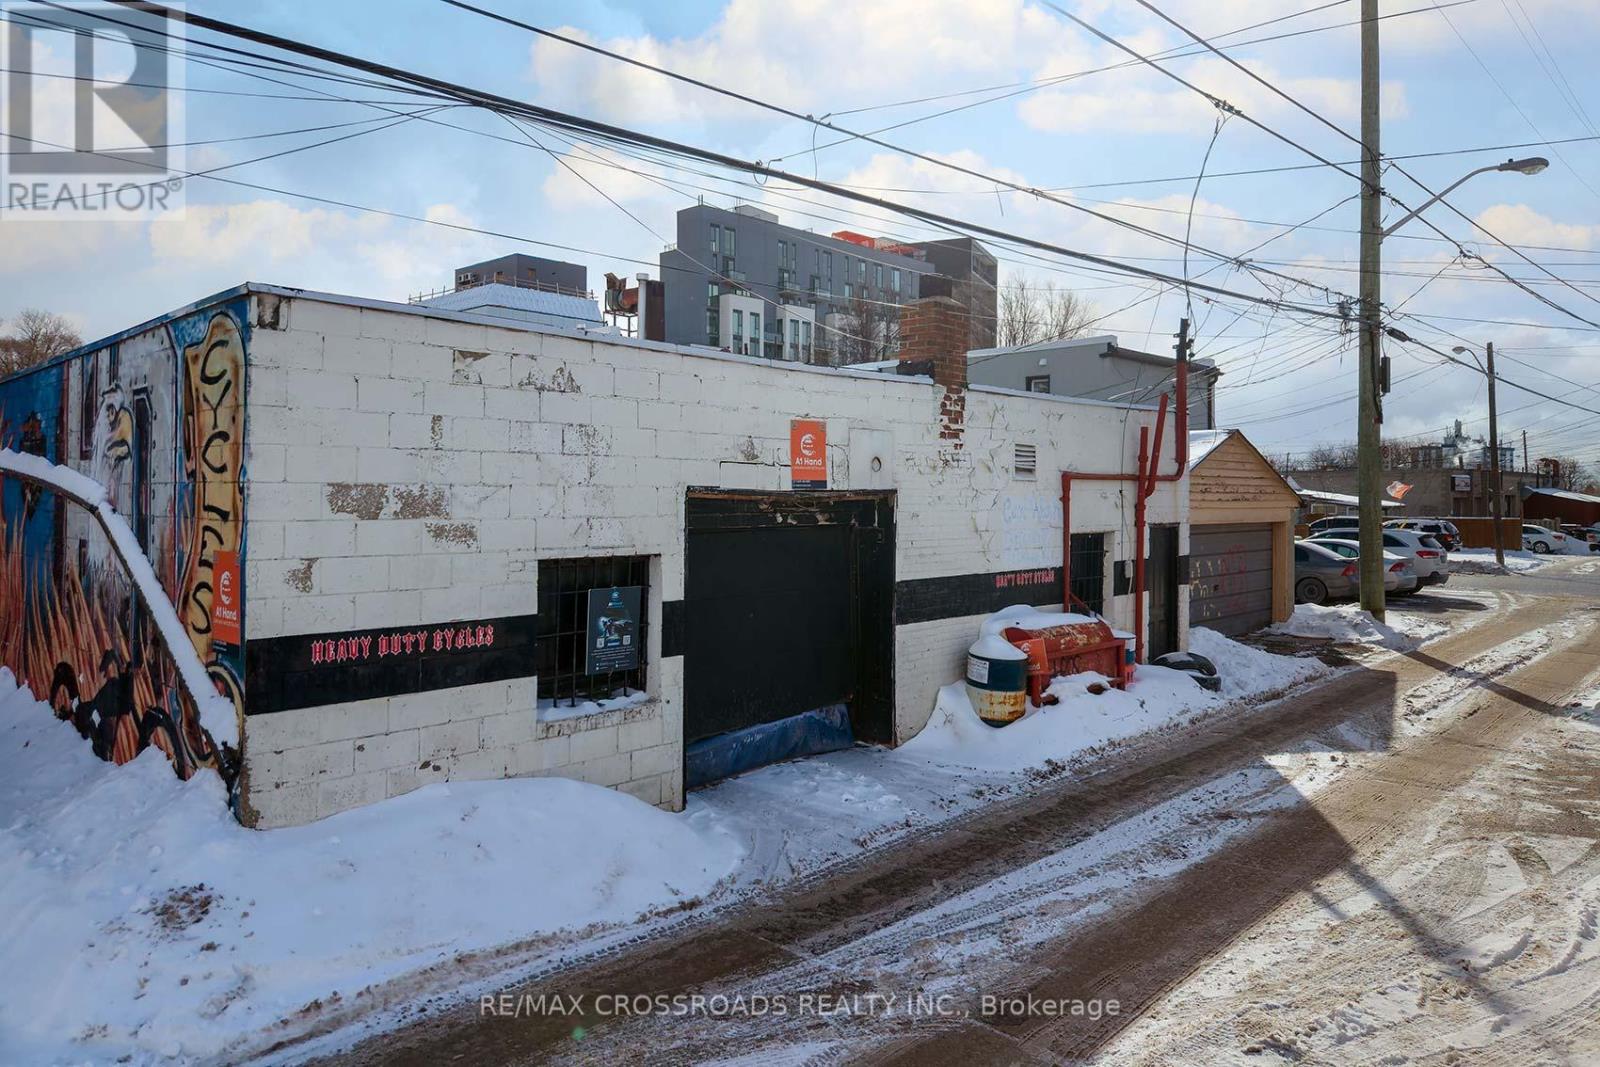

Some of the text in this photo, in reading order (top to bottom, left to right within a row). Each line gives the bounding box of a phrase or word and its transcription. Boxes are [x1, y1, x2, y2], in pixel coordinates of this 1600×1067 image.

[804, 457, 823, 466] Hand
[191, 339, 232, 635] CYCLES
[310, 624, 495, 665] HEAVY DUTY CYCLES
